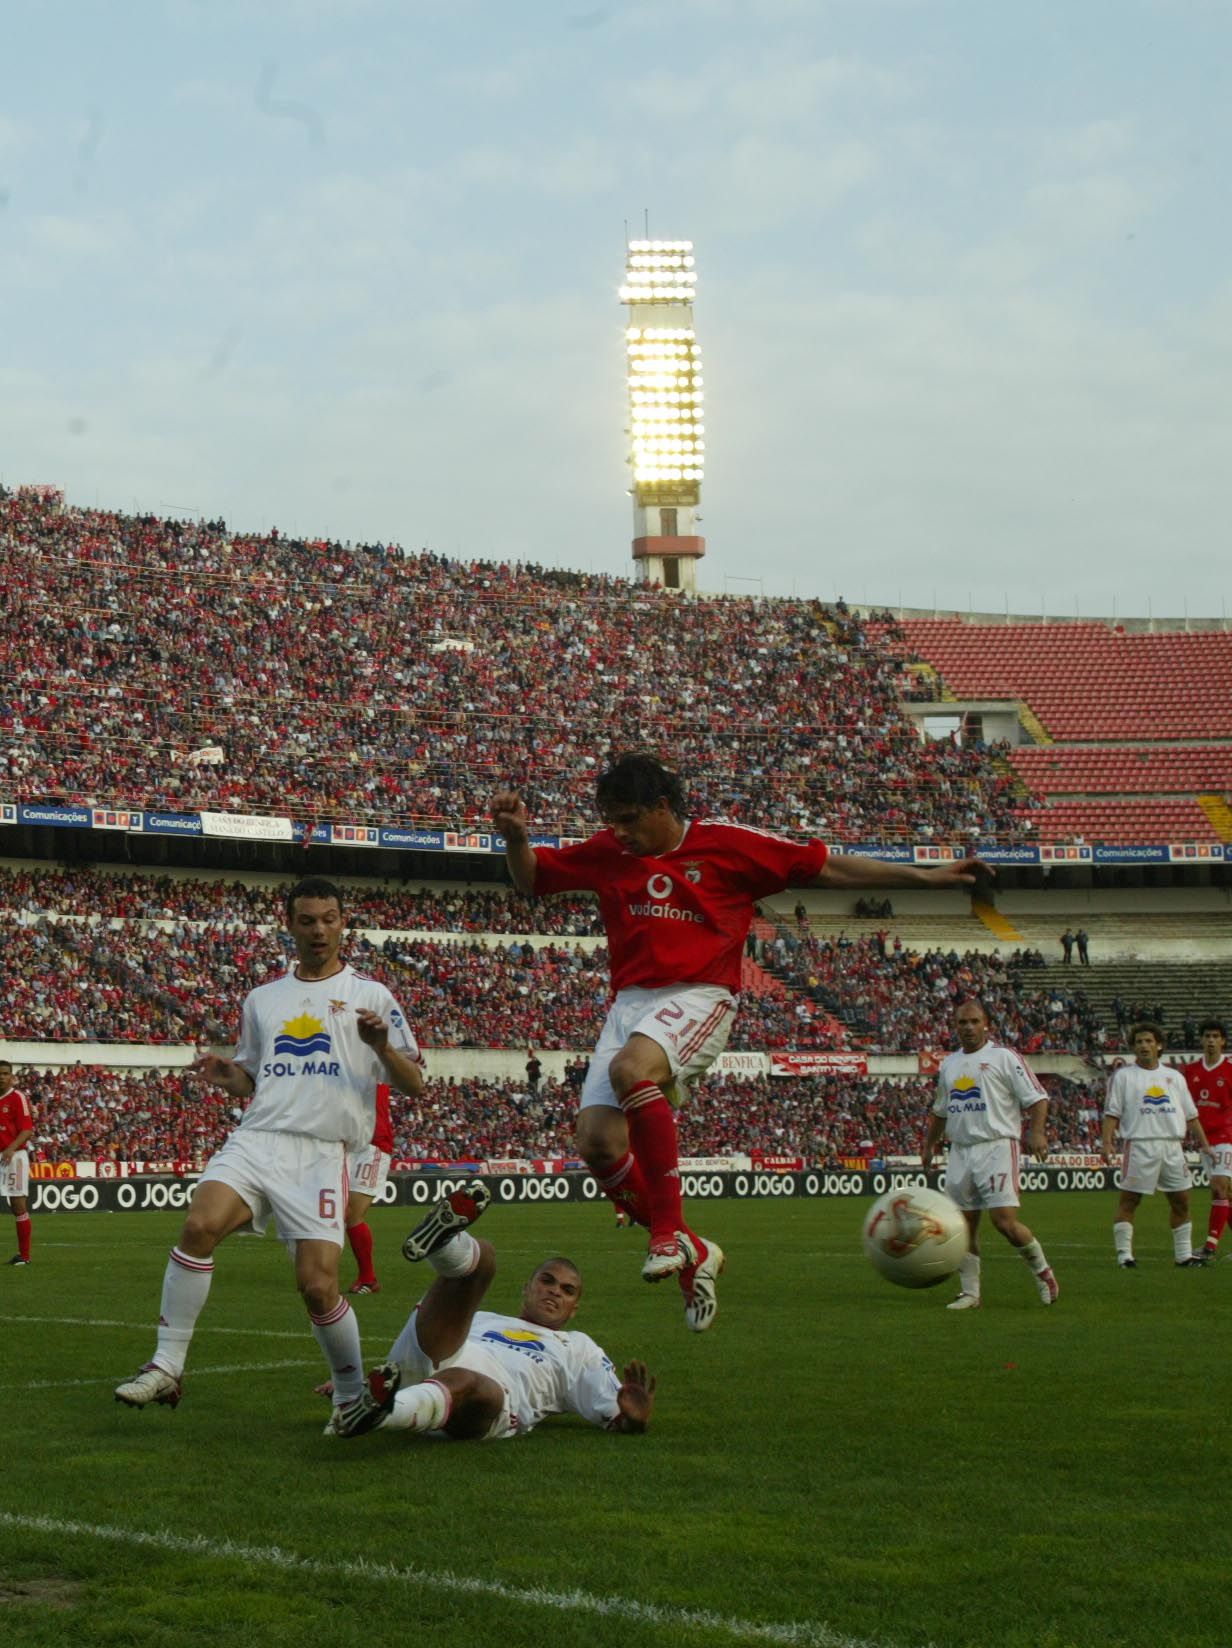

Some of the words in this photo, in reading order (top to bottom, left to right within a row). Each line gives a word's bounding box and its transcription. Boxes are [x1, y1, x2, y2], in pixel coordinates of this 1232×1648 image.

[22, 806, 88, 823] Comunicações
[382, 830, 441, 846] Comunicações
[974, 848, 1035, 860] omunicações
[1096, 847, 1163, 860] Comunicações
[628, 901, 705, 923] vodafone
[264, 1063, 295, 1078] SOL
[302, 1062, 340, 1077] MAR
[722, 1055, 764, 1069] BENFICA
[965, 1103, 987, 1113] MAR
[1139, 1107, 1156, 1115] SOL
[1158, 1106, 1177, 1115] MAR
[354, 1162, 372, 1180] 10
[1049, 1156, 1067, 1166] ASA
[1069, 1156, 1083, 1166] DO
[499, 1178, 516, 1201] O
[519, 1177, 570, 1200] JOGO
[582, 1177, 598, 1199] O
[735, 1176, 749, 1196] O
[751, 1175, 795, 1195] JOGO
[806, 1175, 820, 1195] O
[821, 1175, 863, 1195] JOGO
[873, 1175, 886, 1194] O
[887, 1174, 928, 1192] JOGO
[988, 1173, 1008, 1193] 17
[1057, 1171, 1068, 1190] O
[1070, 1170, 1105, 1190] JOGO
[32, 1184, 99, 1210] JOGO
[117, 1183, 137, 1209] O
[412, 1180, 430, 1203] O
[318, 1188, 337, 1220] 6
